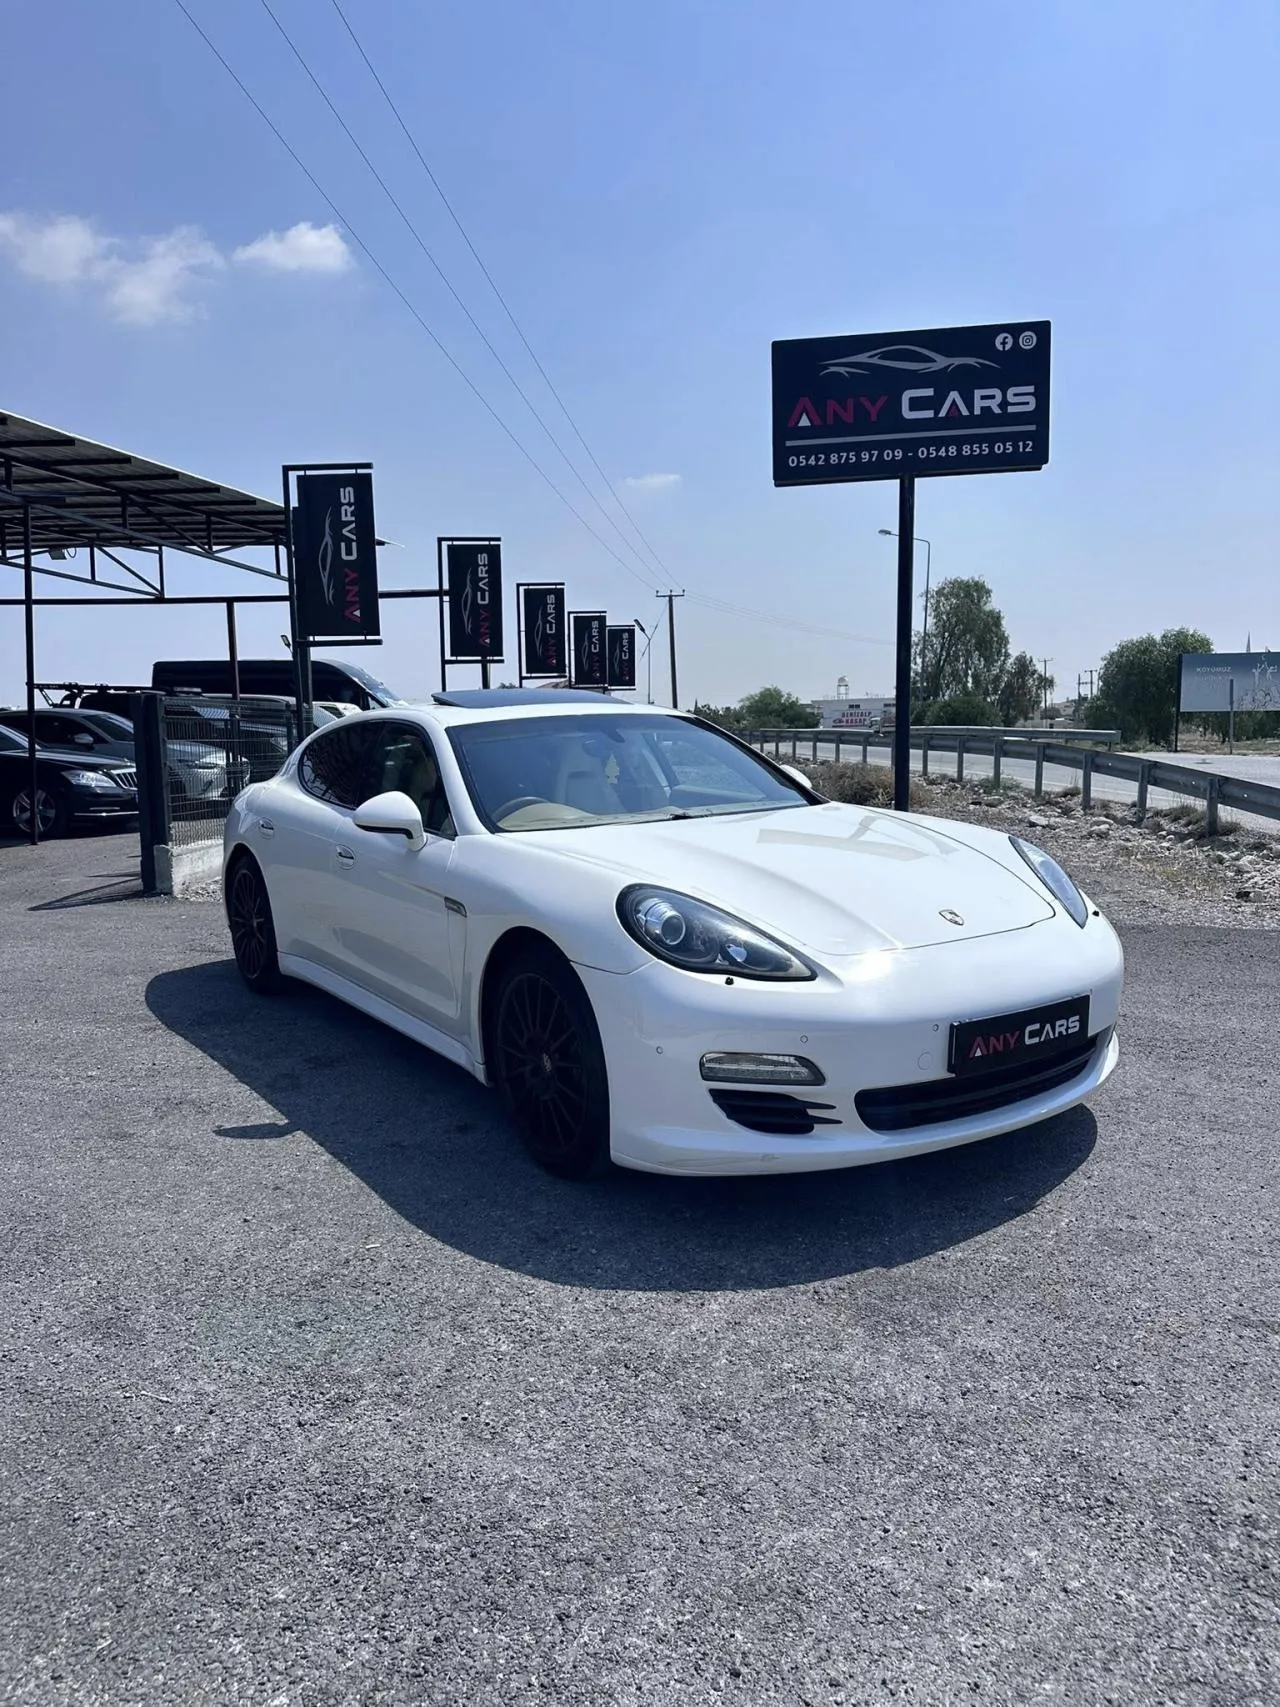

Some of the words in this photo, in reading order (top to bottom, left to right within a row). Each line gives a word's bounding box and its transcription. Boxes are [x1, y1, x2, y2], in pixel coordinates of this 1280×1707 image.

[787, 396, 888, 427] ANY
[902, 385, 1036, 420] CARS
[788, 454, 826, 467] 0542
[829, 452, 857, 465] 875
[860, 450, 879, 463] 97
[883, 448, 903, 461] 09
[917, 445, 958, 459] 0548
[961, 443, 990, 457] 855
[993, 441, 1014, 454] 05
[1017, 440, 1033, 453] 12
[340, 486, 358, 560] CARS
[344, 567, 361, 623] ANY
[477, 552, 489, 605] CARS
[479, 609, 490, 648] ANY
[546, 594, 556, 634] CARS
[591, 620, 599, 653] CARS
[968, 1030, 1021, 1058] ANY
[1024, 1015, 1080, 1046] CARS
